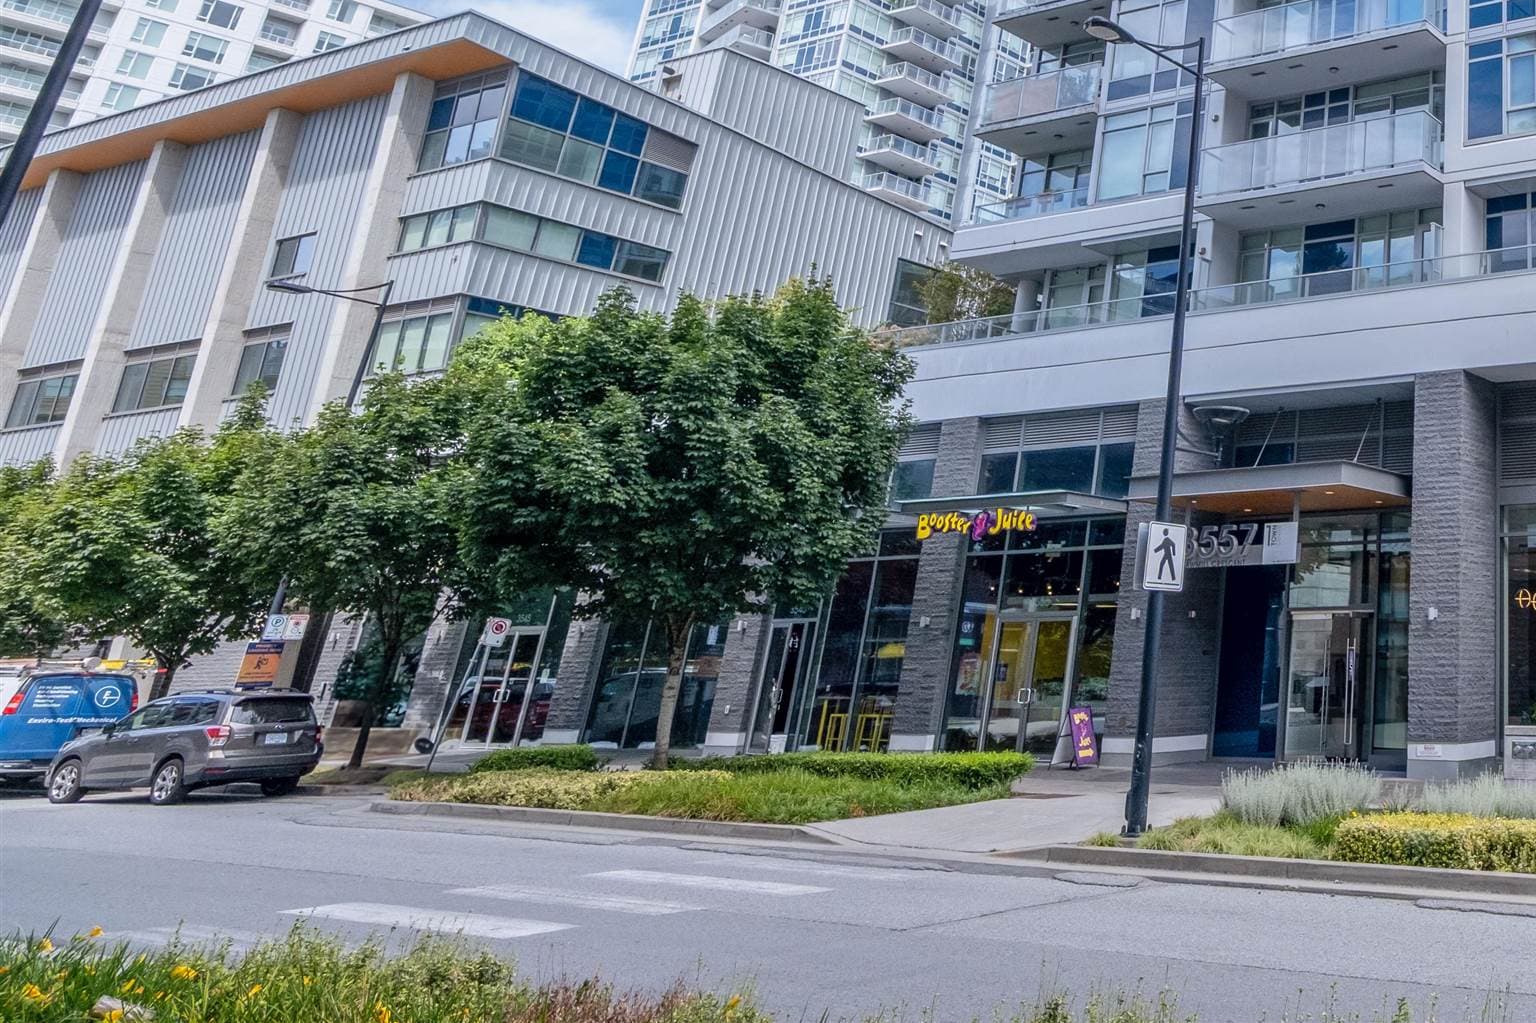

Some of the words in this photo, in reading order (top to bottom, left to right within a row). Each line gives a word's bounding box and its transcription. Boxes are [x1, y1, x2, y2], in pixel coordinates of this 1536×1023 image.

[917, 512, 971, 540] Booster
[988, 508, 1033, 534] Juice
[1186, 523, 1259, 558] 3557
